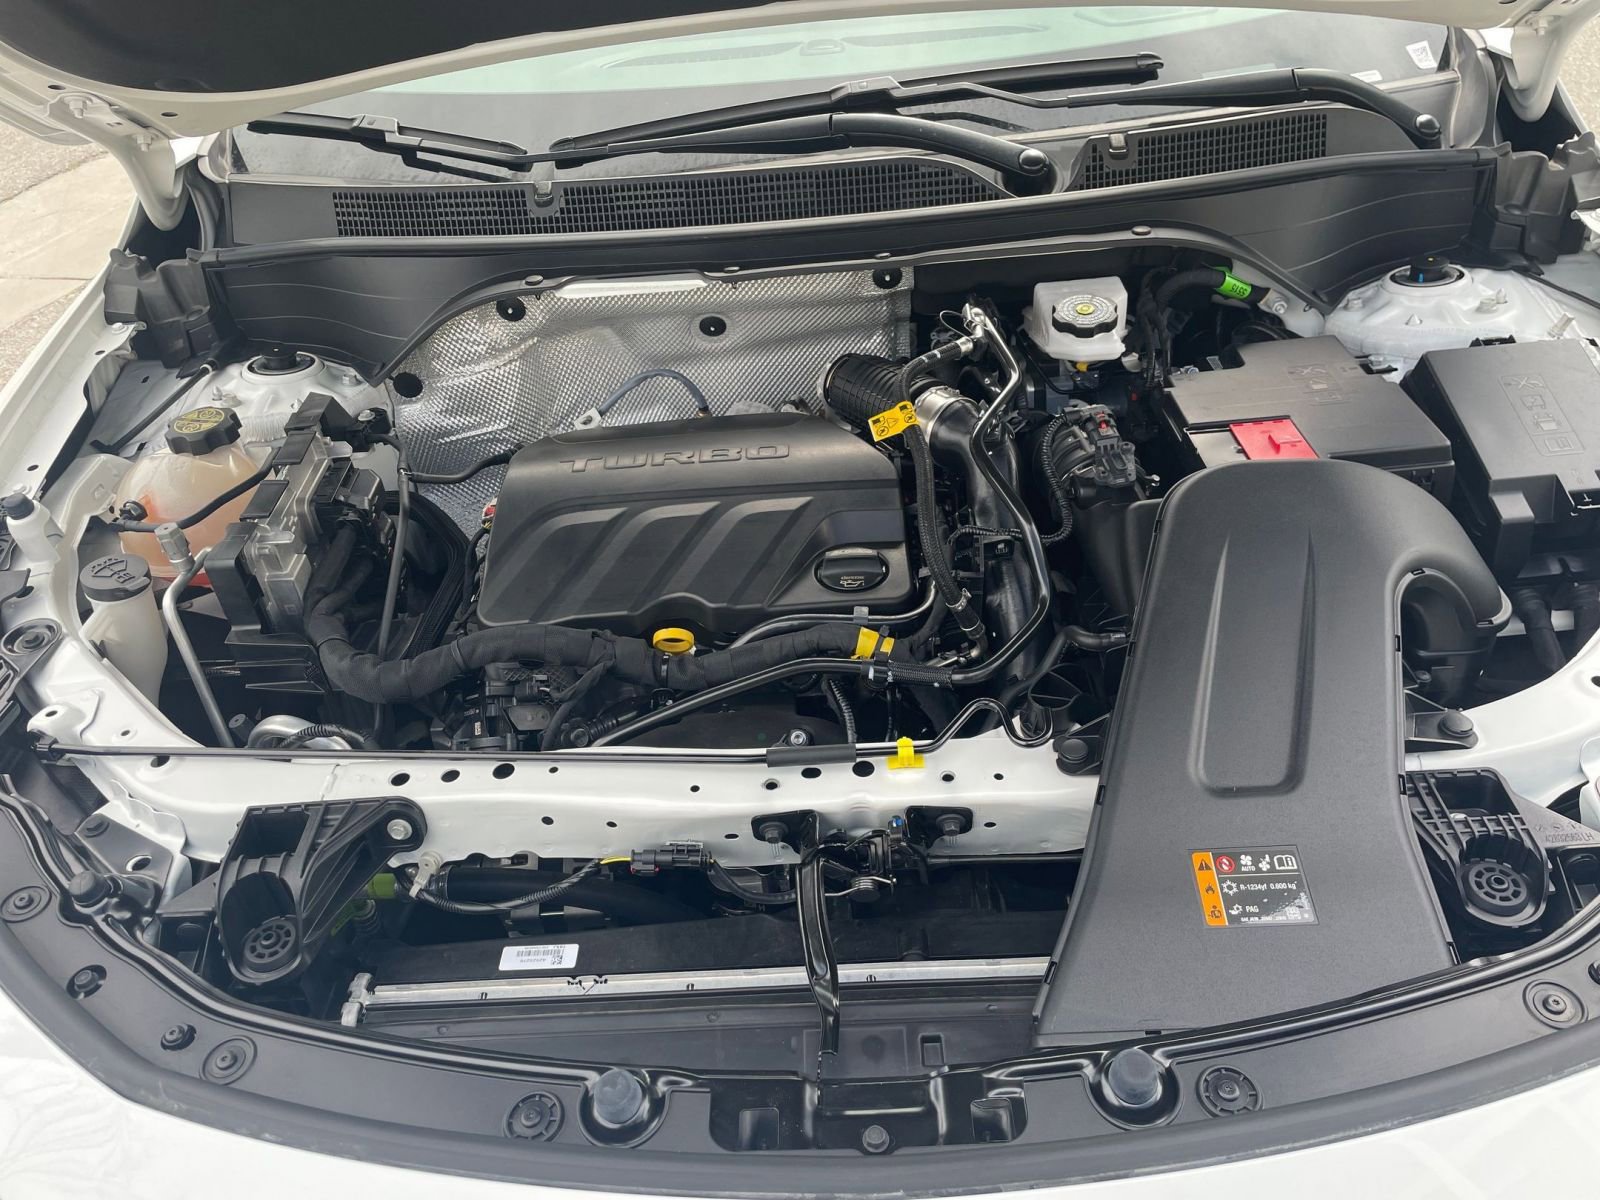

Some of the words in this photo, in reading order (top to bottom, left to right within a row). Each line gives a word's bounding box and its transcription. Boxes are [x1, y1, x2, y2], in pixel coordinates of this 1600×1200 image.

[559, 444, 790, 473] TURBO
[1239, 882, 1267, 892] R-1234yf
[1245, 905, 1259, 913] PAG
